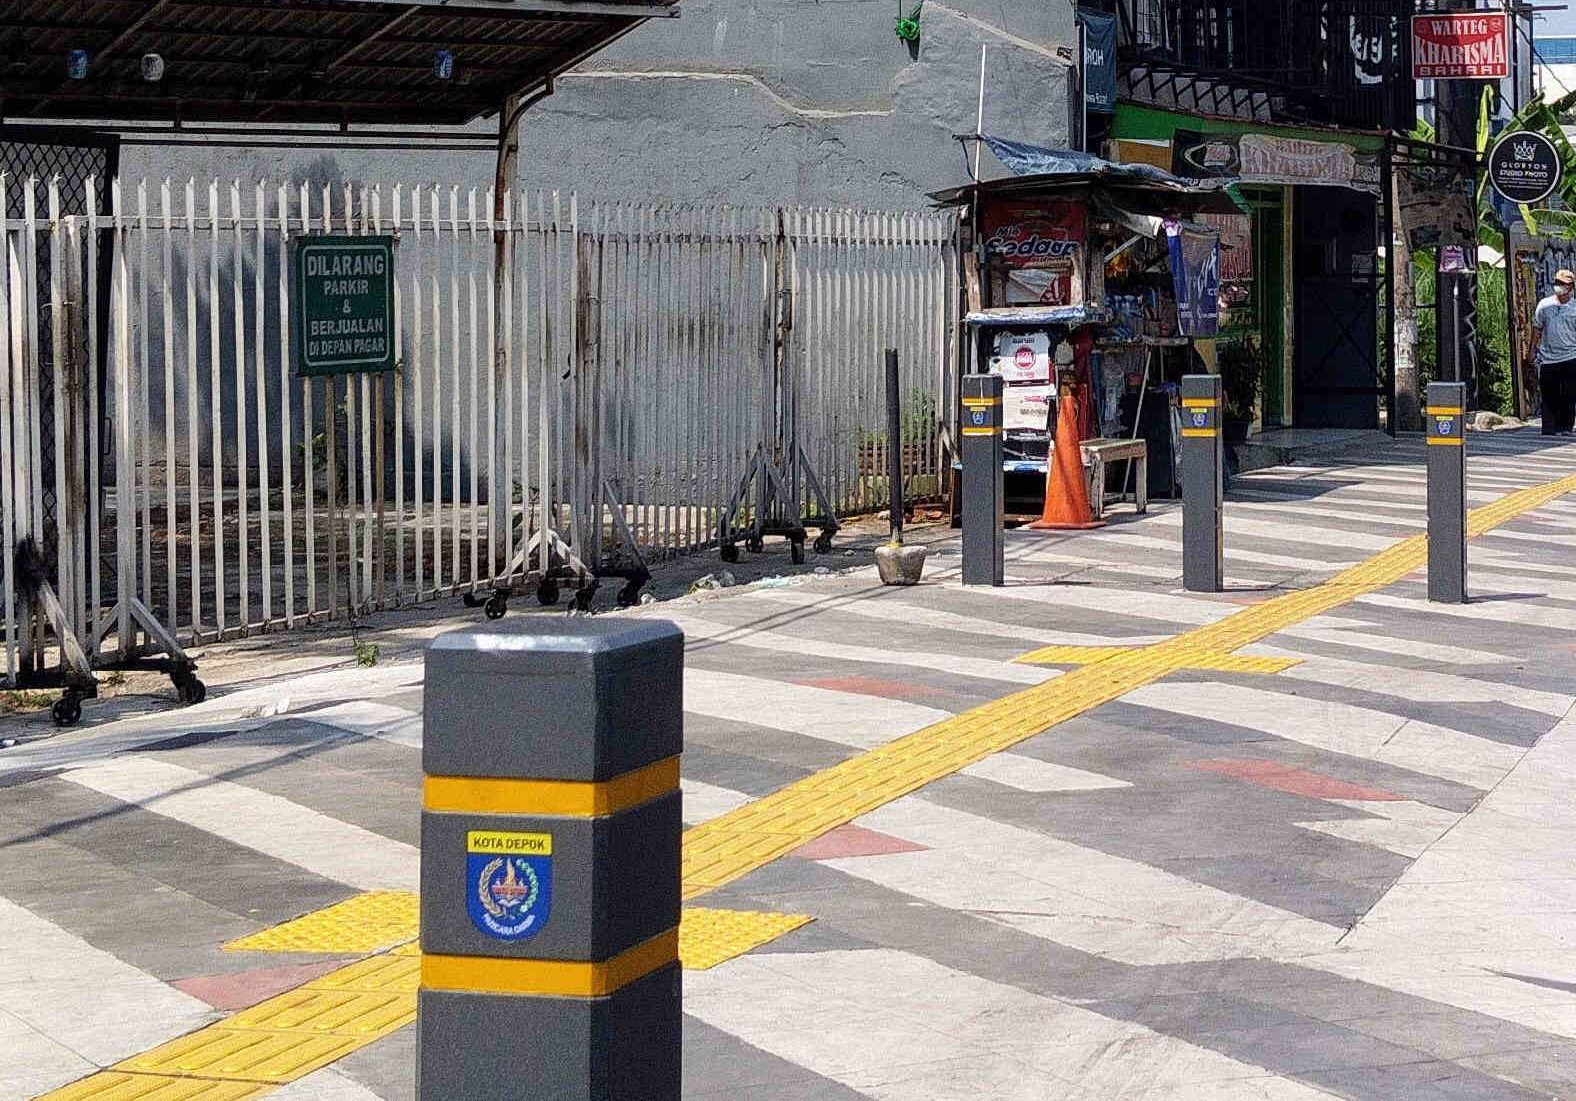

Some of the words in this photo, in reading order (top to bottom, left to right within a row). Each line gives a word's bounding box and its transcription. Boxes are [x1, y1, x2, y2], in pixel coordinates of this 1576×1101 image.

[1431, 19, 1488, 36] WARTEG
[1415, 33, 1505, 66] KHARISMA
[1420, 65, 1502, 76] BAHARI
[307, 254, 384, 276] DILARANG
[323, 279, 369, 296] PARKIR
[342, 299, 352, 313] &
[311, 318, 383, 335] BERJUALAN
[309, 340, 320, 356] DI
[321, 339, 352, 356] DEPAN
[354, 337, 385, 353] PAGAR
[473, 837, 504, 849] KOTA
[506, 839, 545, 850] DEPOK
